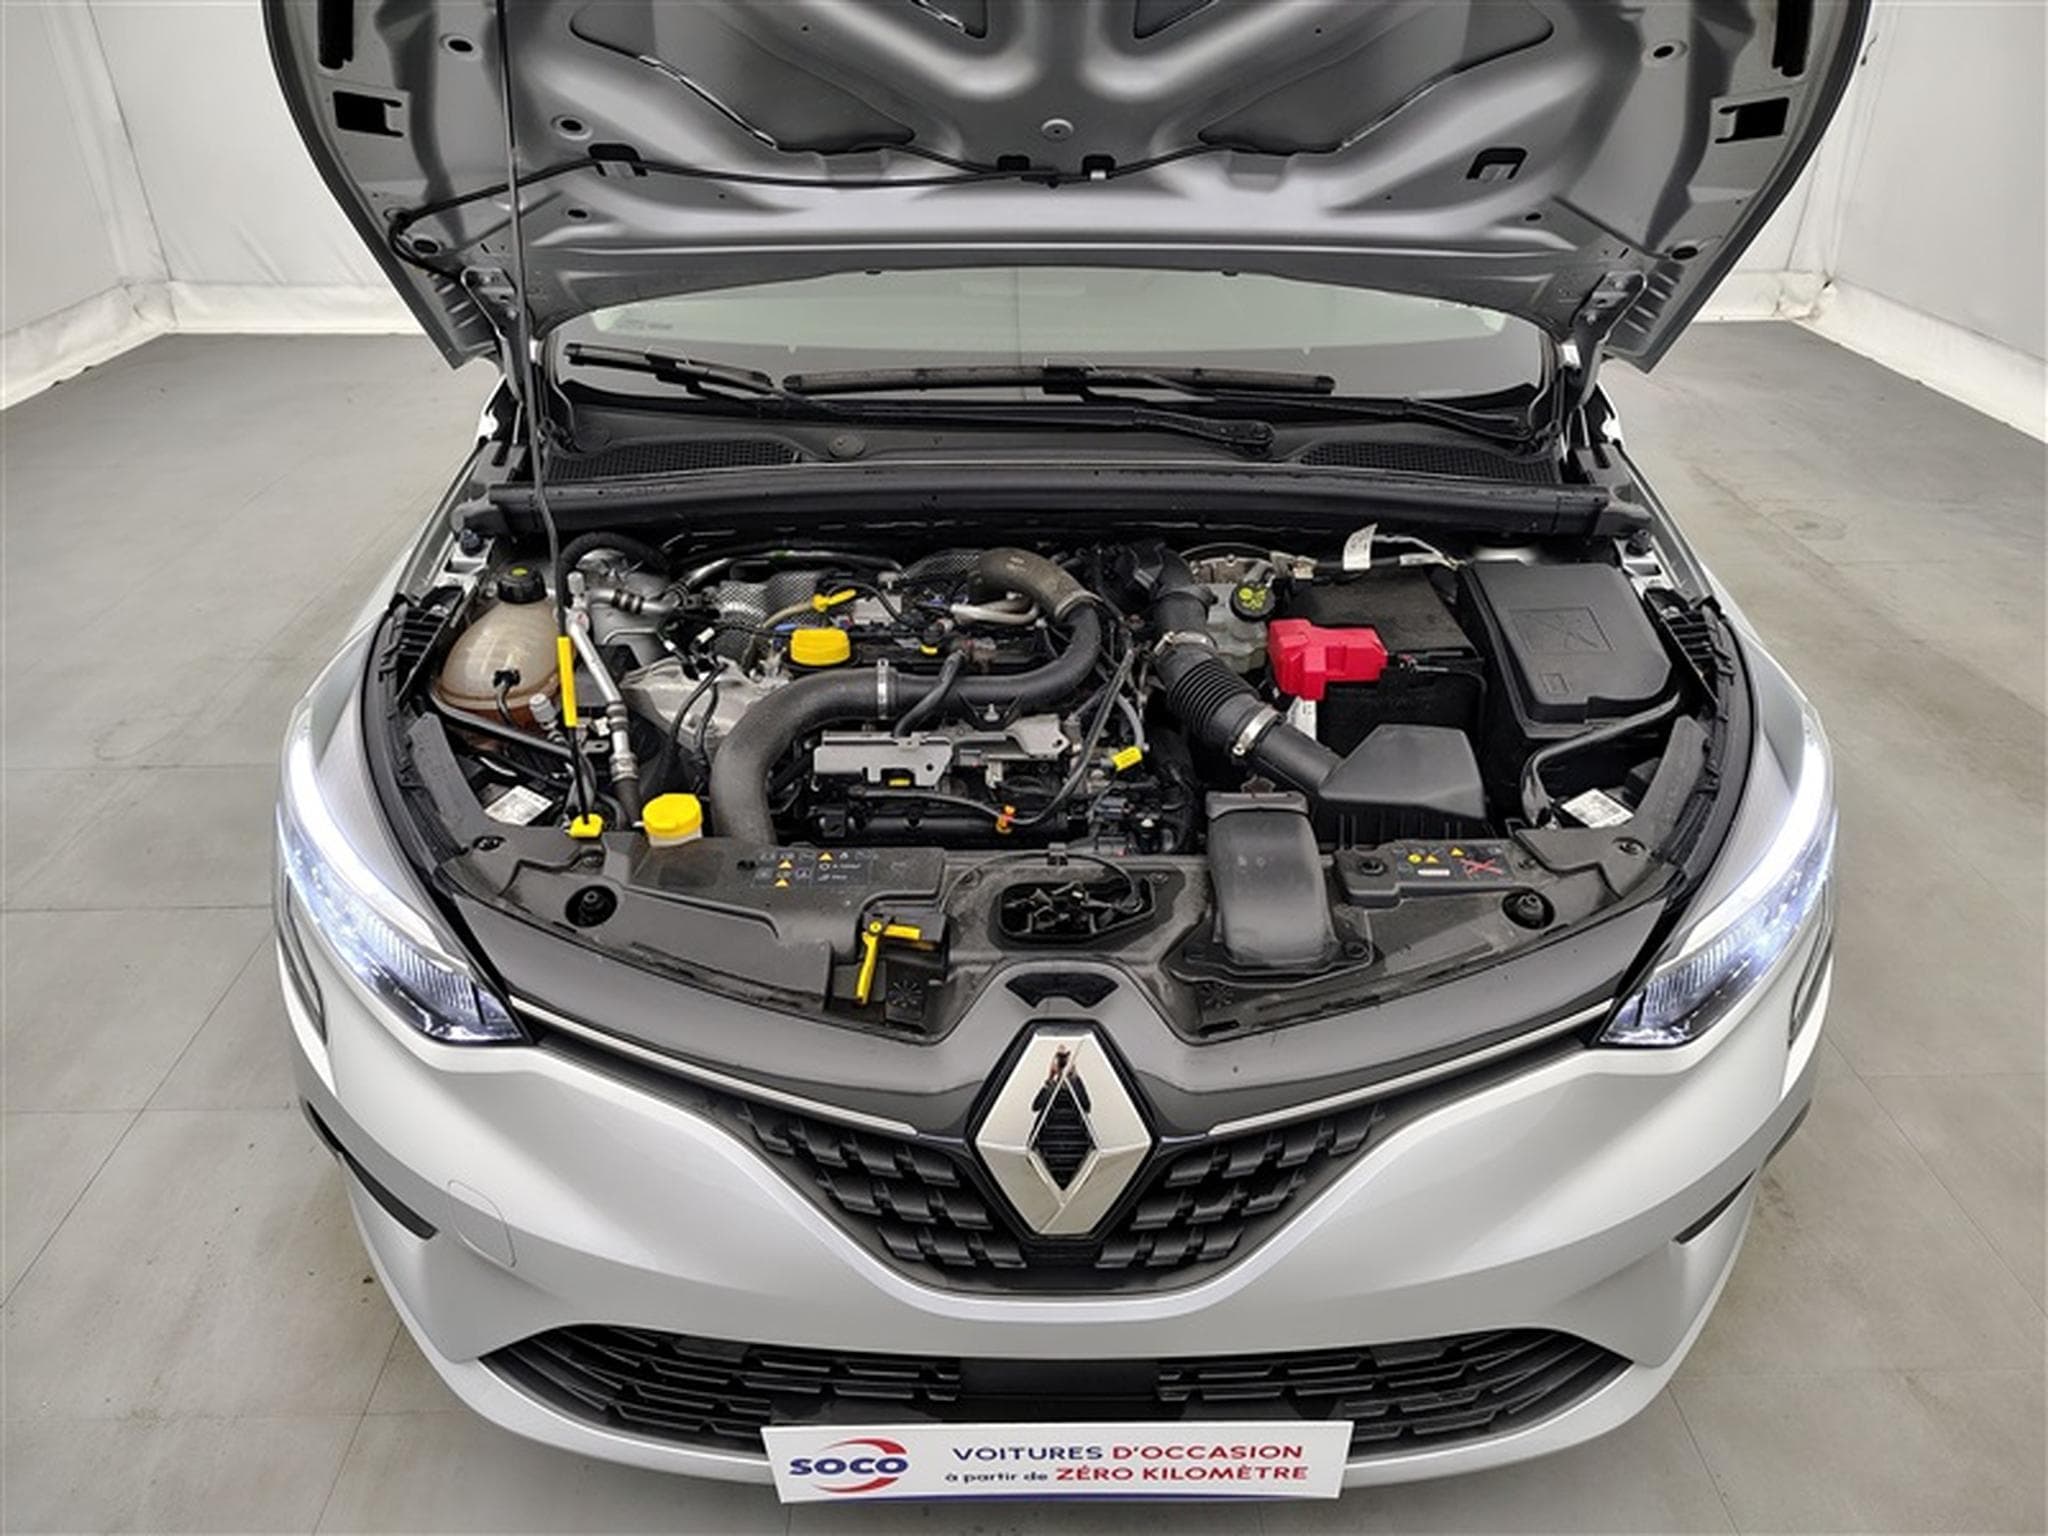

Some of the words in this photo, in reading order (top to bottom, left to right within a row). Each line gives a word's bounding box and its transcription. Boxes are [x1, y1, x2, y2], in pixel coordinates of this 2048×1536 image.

[952, 1446, 1104, 1461] VOITURES
[1112, 1445, 1303, 1460] D'OCCASION
[789, 1457, 909, 1476] SOCO
[963, 1471, 1018, 1484] partir
[1023, 1471, 1048, 1482] de
[1055, 1465, 1134, 1481] ZÉRO
[1142, 1464, 1309, 1480] KILOMÈTRE
